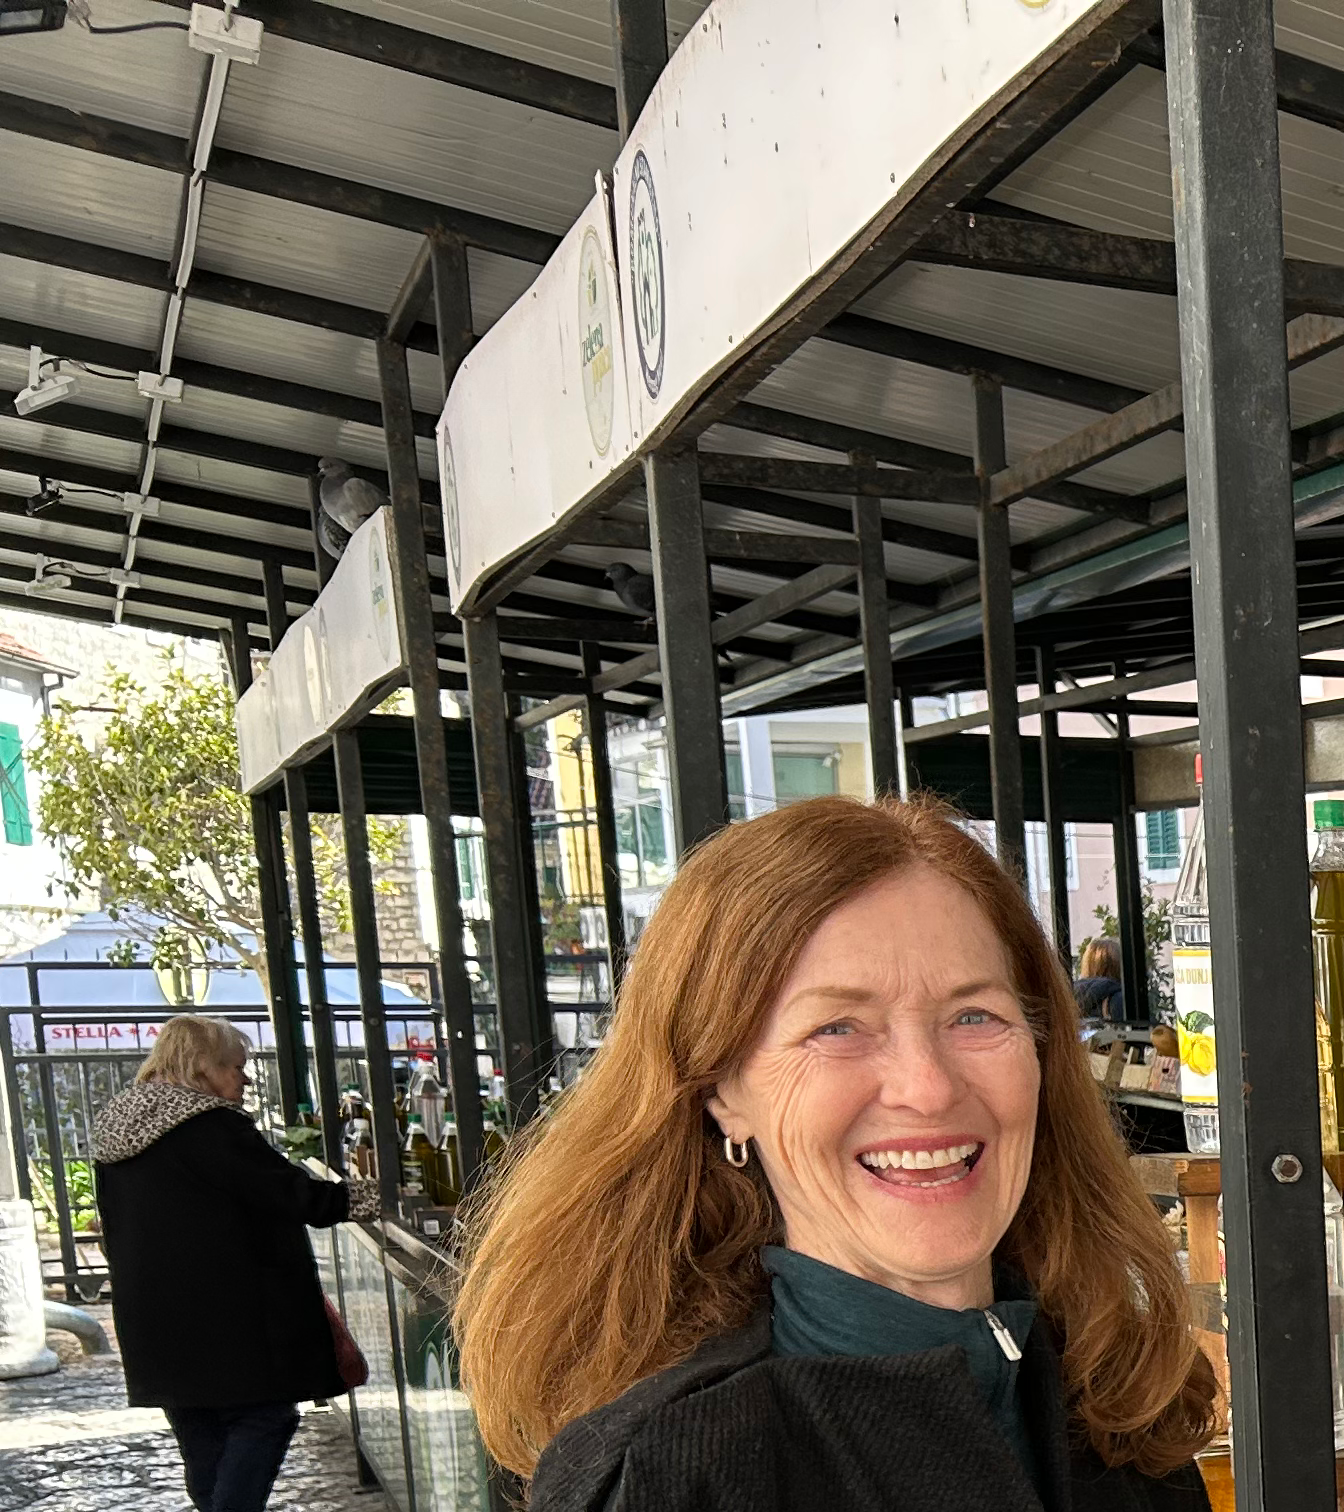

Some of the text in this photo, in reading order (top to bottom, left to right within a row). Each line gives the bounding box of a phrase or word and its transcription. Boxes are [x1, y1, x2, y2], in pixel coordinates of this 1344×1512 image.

[1186, 968, 1212, 984] DUNJ
[52, 1024, 164, 1040] STELLA A
